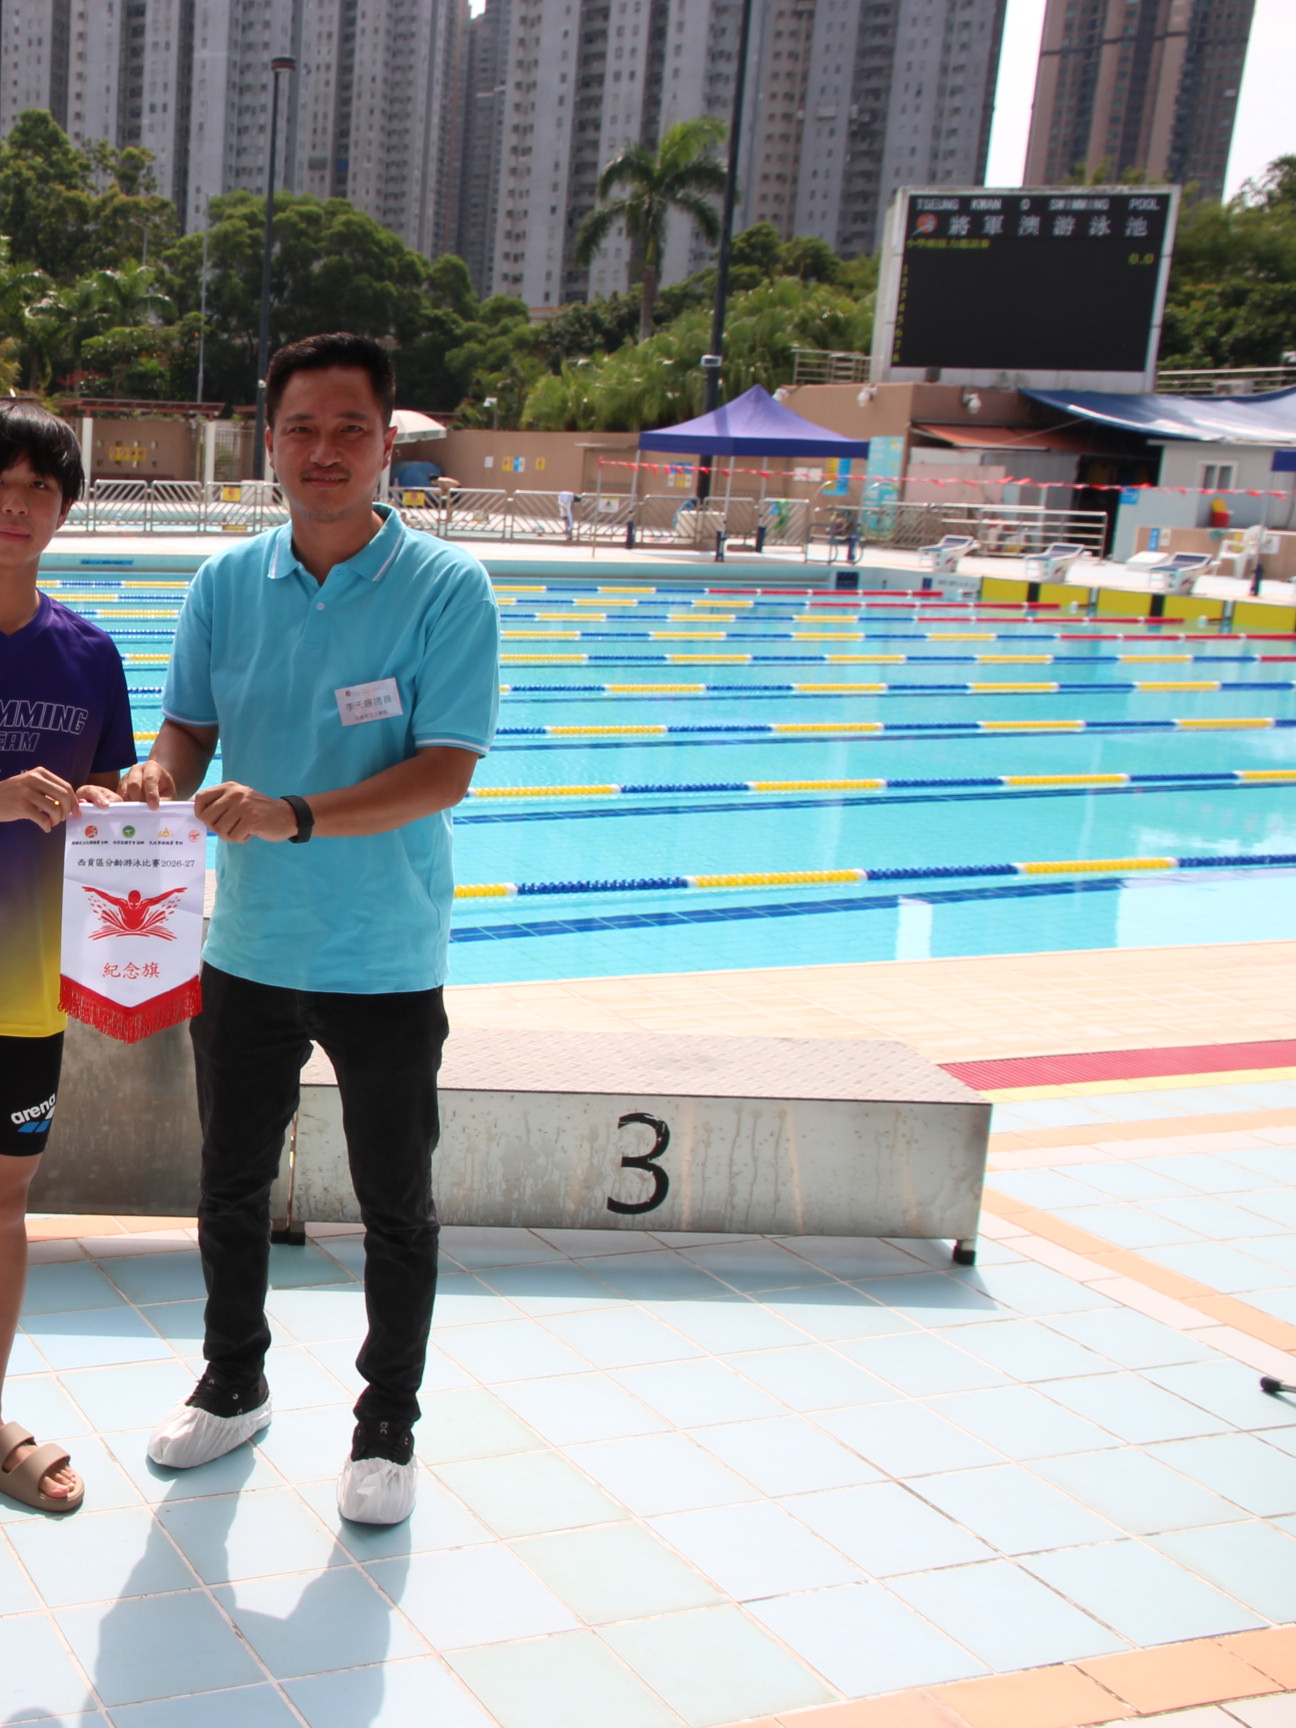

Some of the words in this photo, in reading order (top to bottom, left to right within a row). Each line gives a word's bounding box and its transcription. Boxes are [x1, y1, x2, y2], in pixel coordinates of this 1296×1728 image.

[917, 198, 960, 210] TSEUNG
[970, 198, 1002, 210] KWAN
[1020, 198, 1031, 211] O
[1048, 198, 1110, 211] SWIMMING
[1128, 198, 1161, 211] POOL
[102, 961, 161, 980] 紀念旗
[10, 1092, 56, 1125] arena
[606, 1112, 671, 1215] 3
